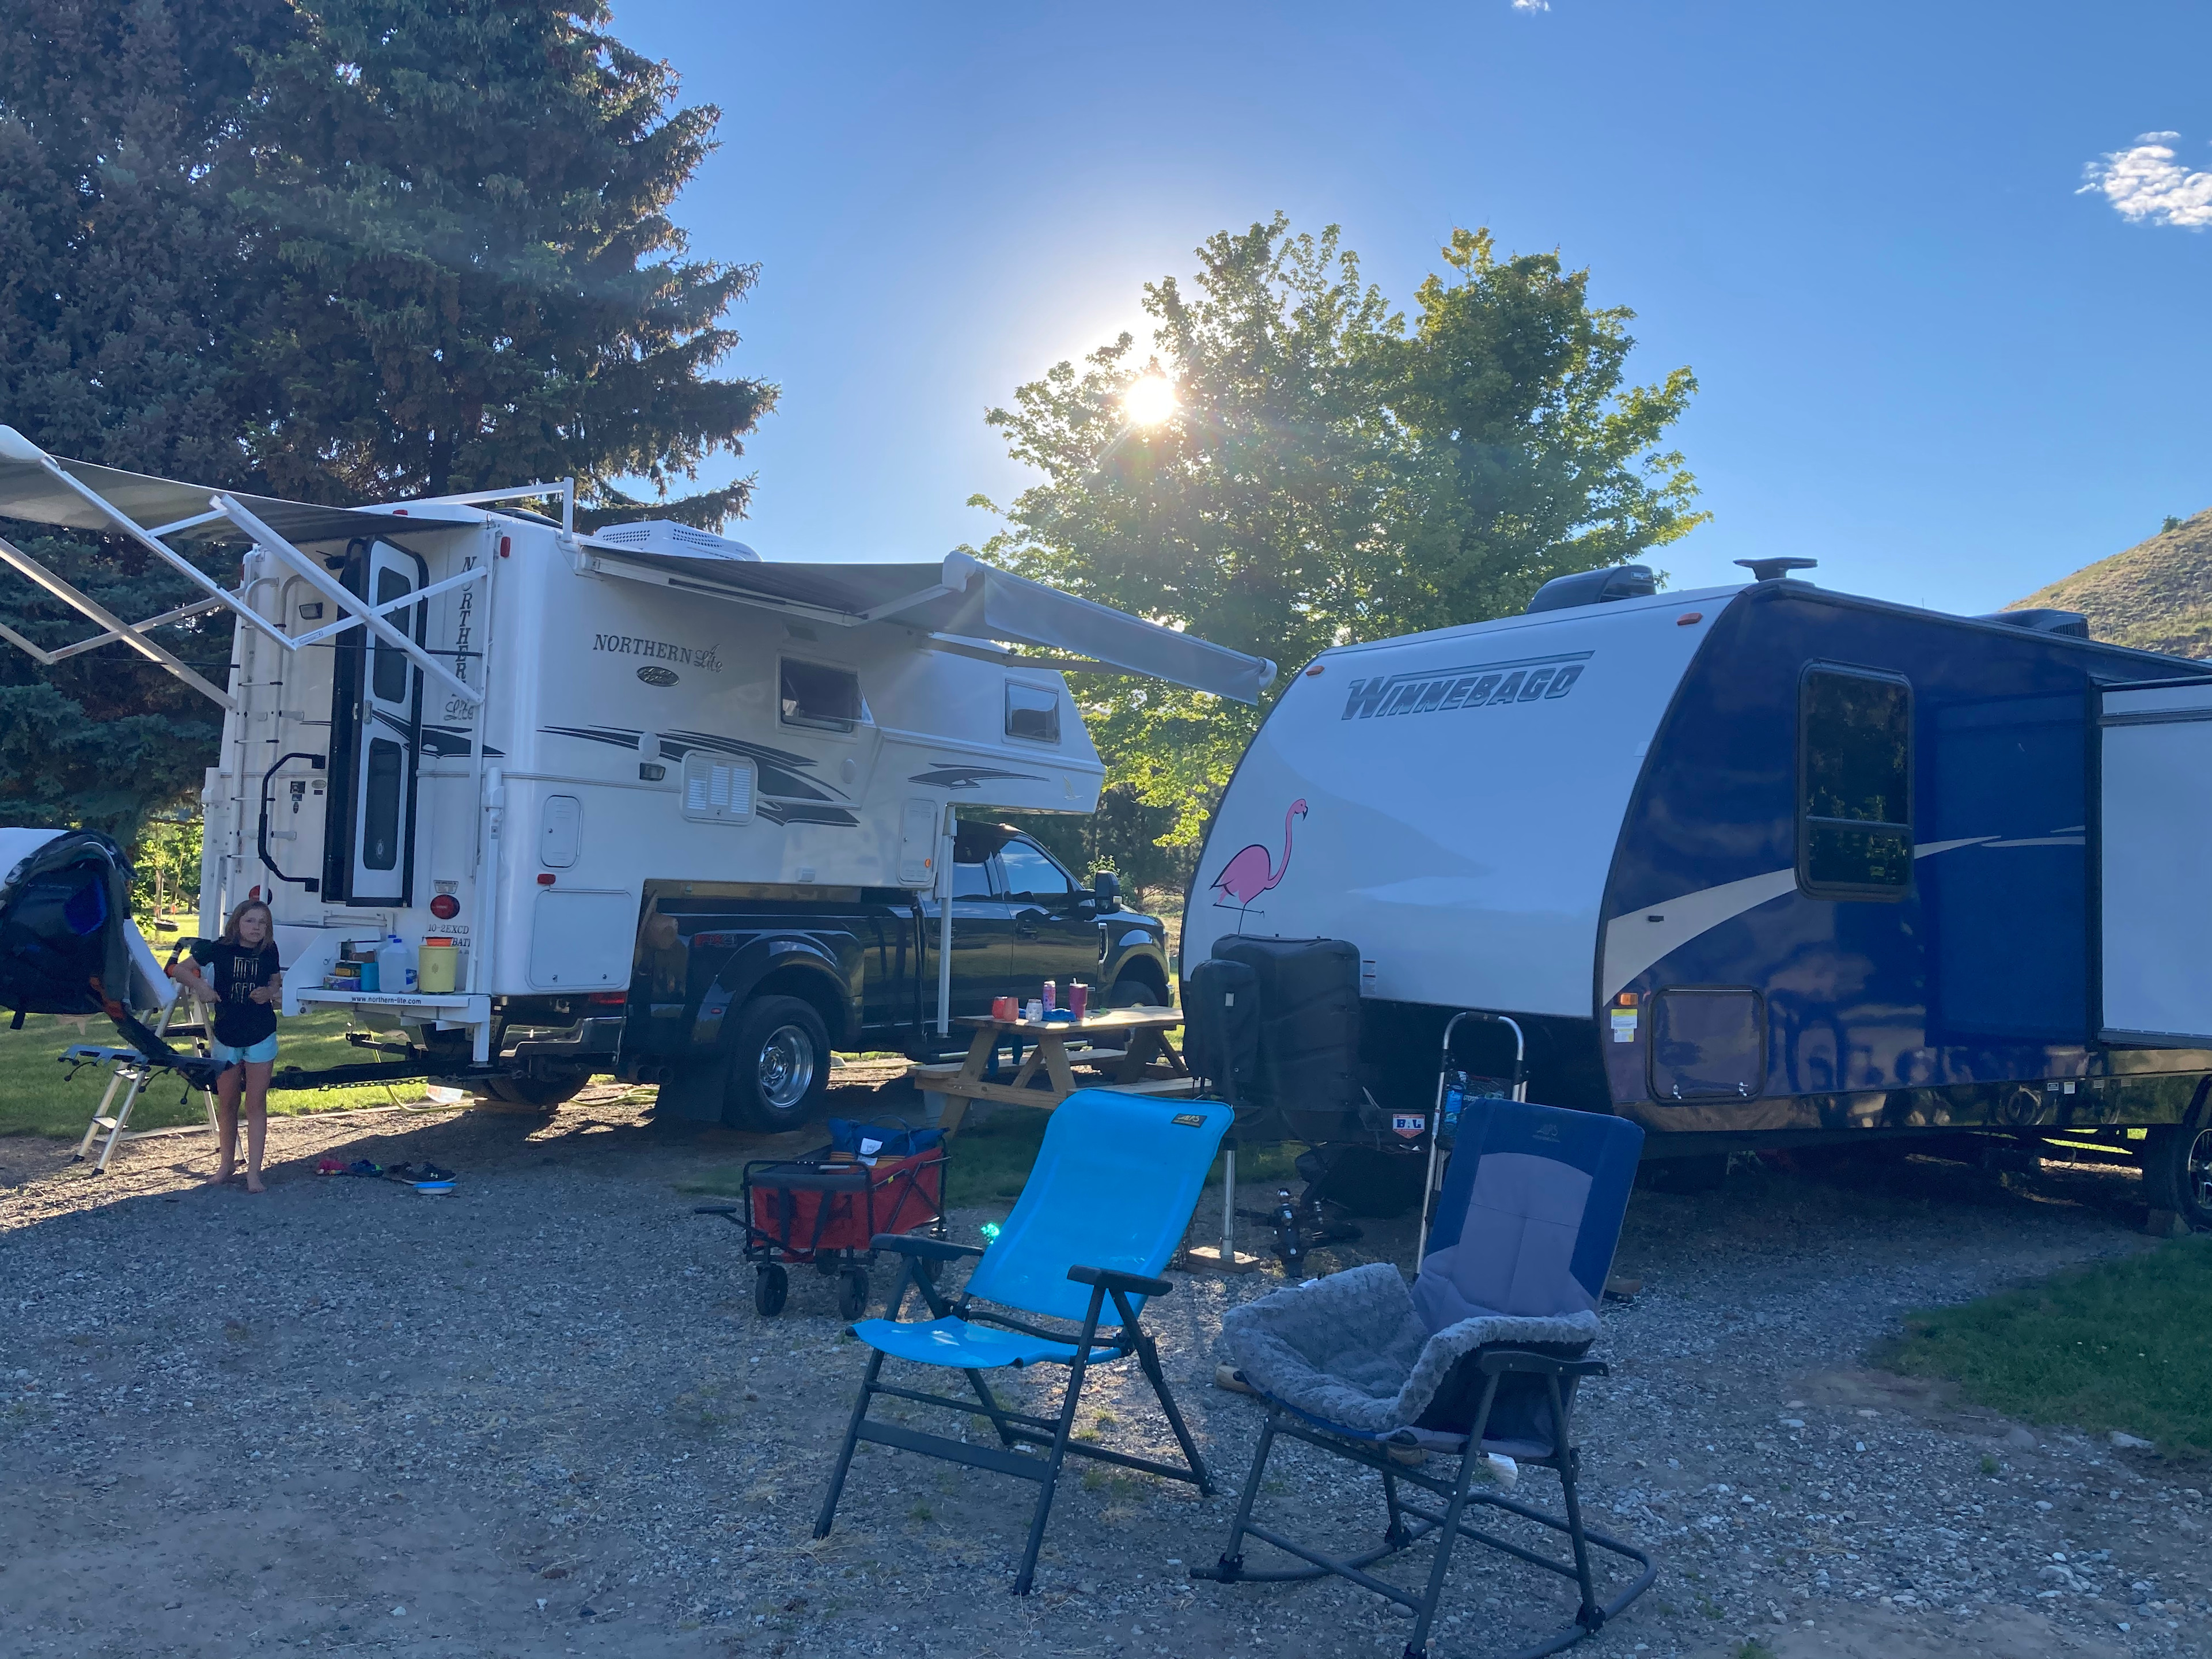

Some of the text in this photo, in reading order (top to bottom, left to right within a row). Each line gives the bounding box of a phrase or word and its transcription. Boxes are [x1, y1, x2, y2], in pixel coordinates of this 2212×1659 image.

[593, 634, 722, 673] NORTHERN Lite
[1342, 663, 1586, 721] WINNEBAGO
[351, 996, 422, 1005] www.northern-lite.com
